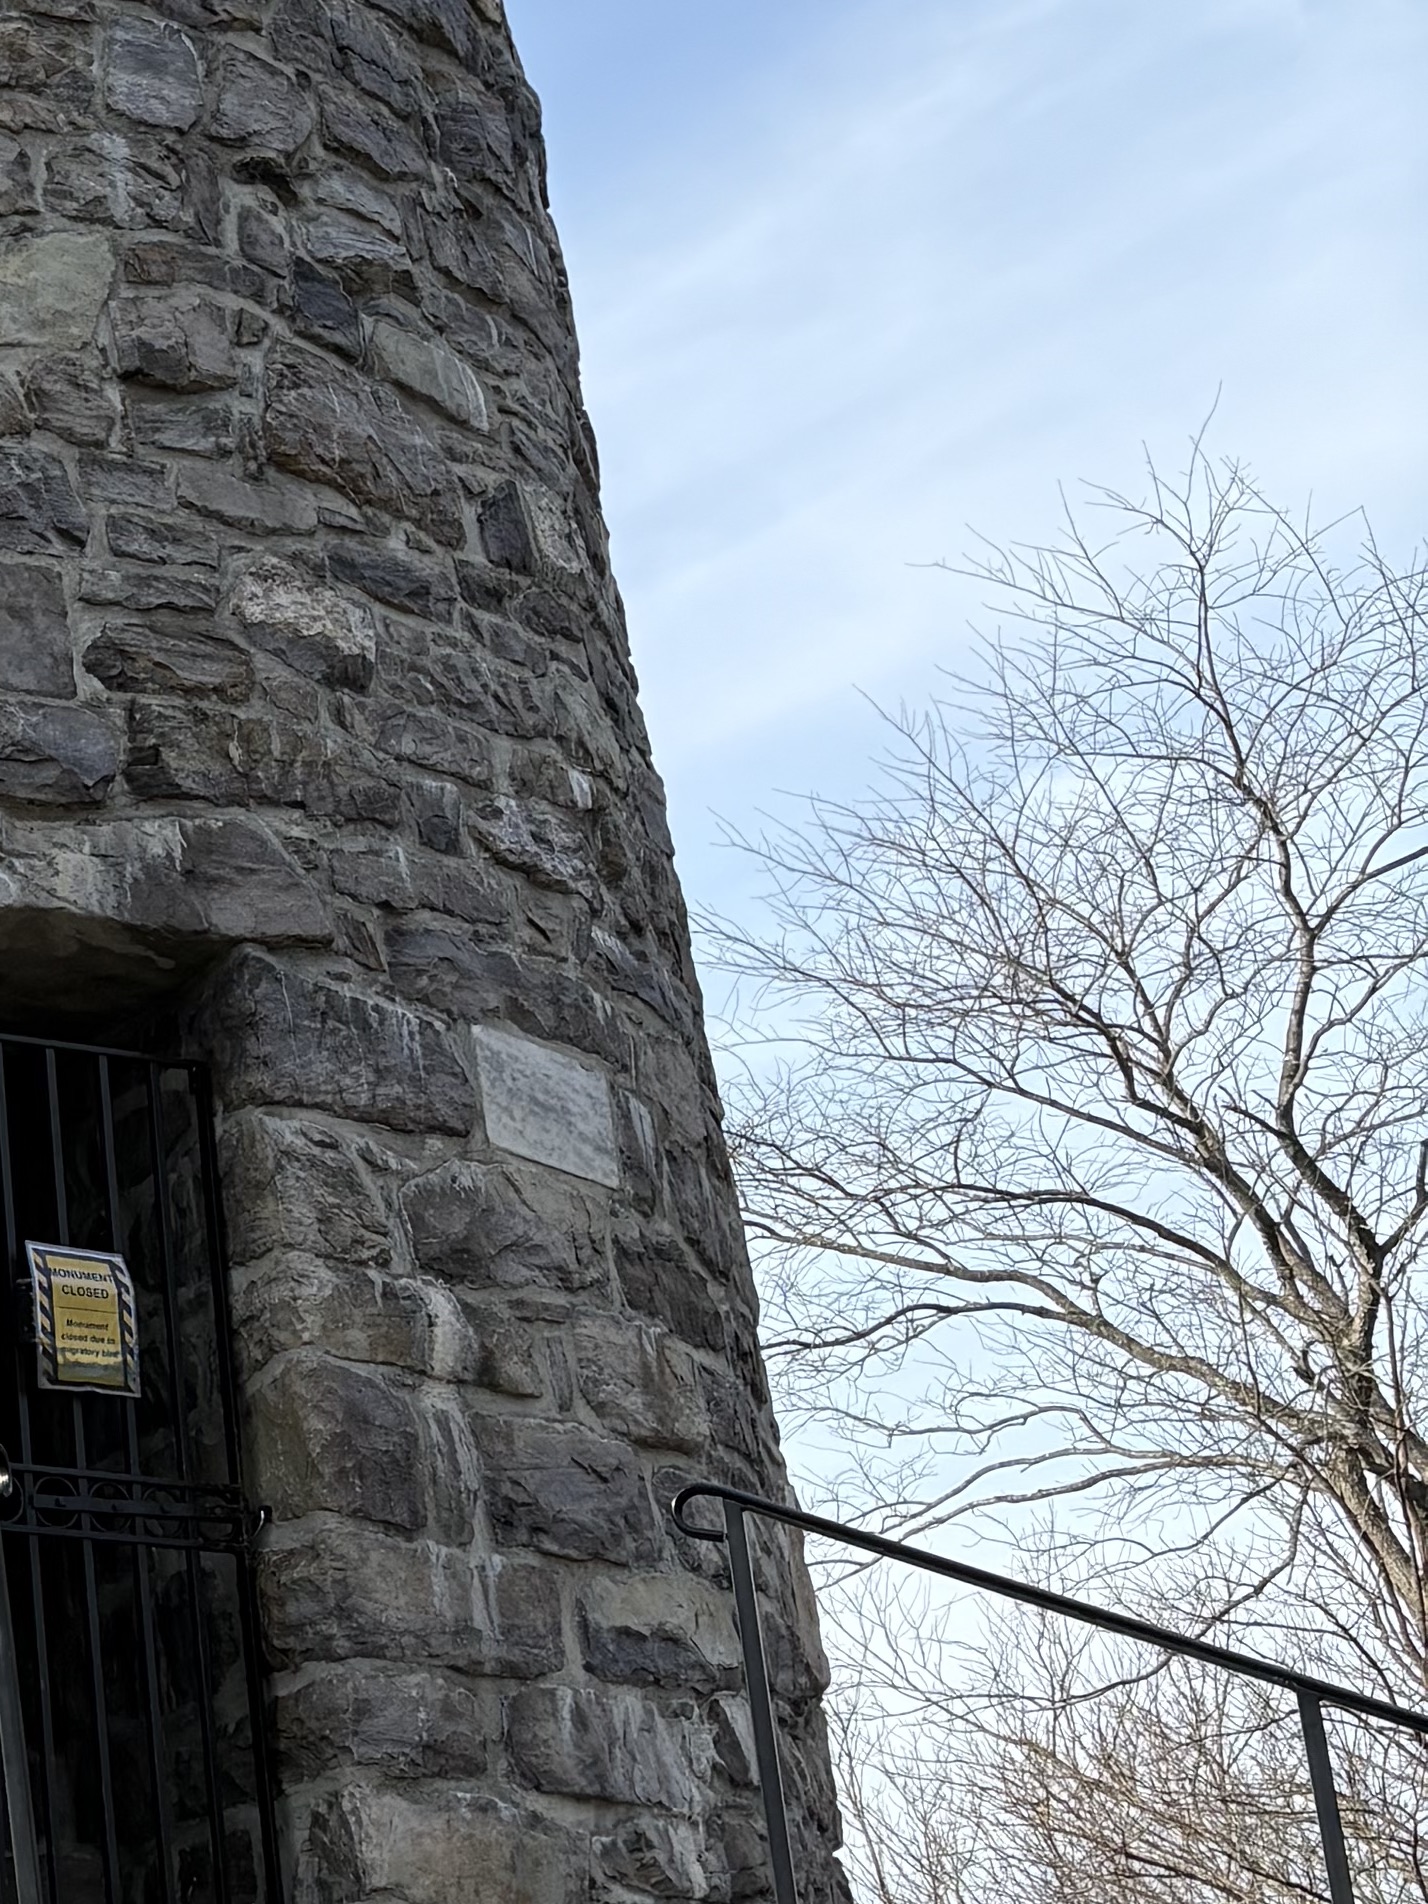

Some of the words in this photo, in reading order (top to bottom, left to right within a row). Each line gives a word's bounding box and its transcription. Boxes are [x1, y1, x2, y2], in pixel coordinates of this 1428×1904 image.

[49, 1268, 113, 1283] MONUMENT
[61, 1284, 109, 1299] CLOSED
[66, 1319, 108, 1331] Monument
[61, 1333, 88, 1342] closed
[89, 1335, 105, 1344] due
